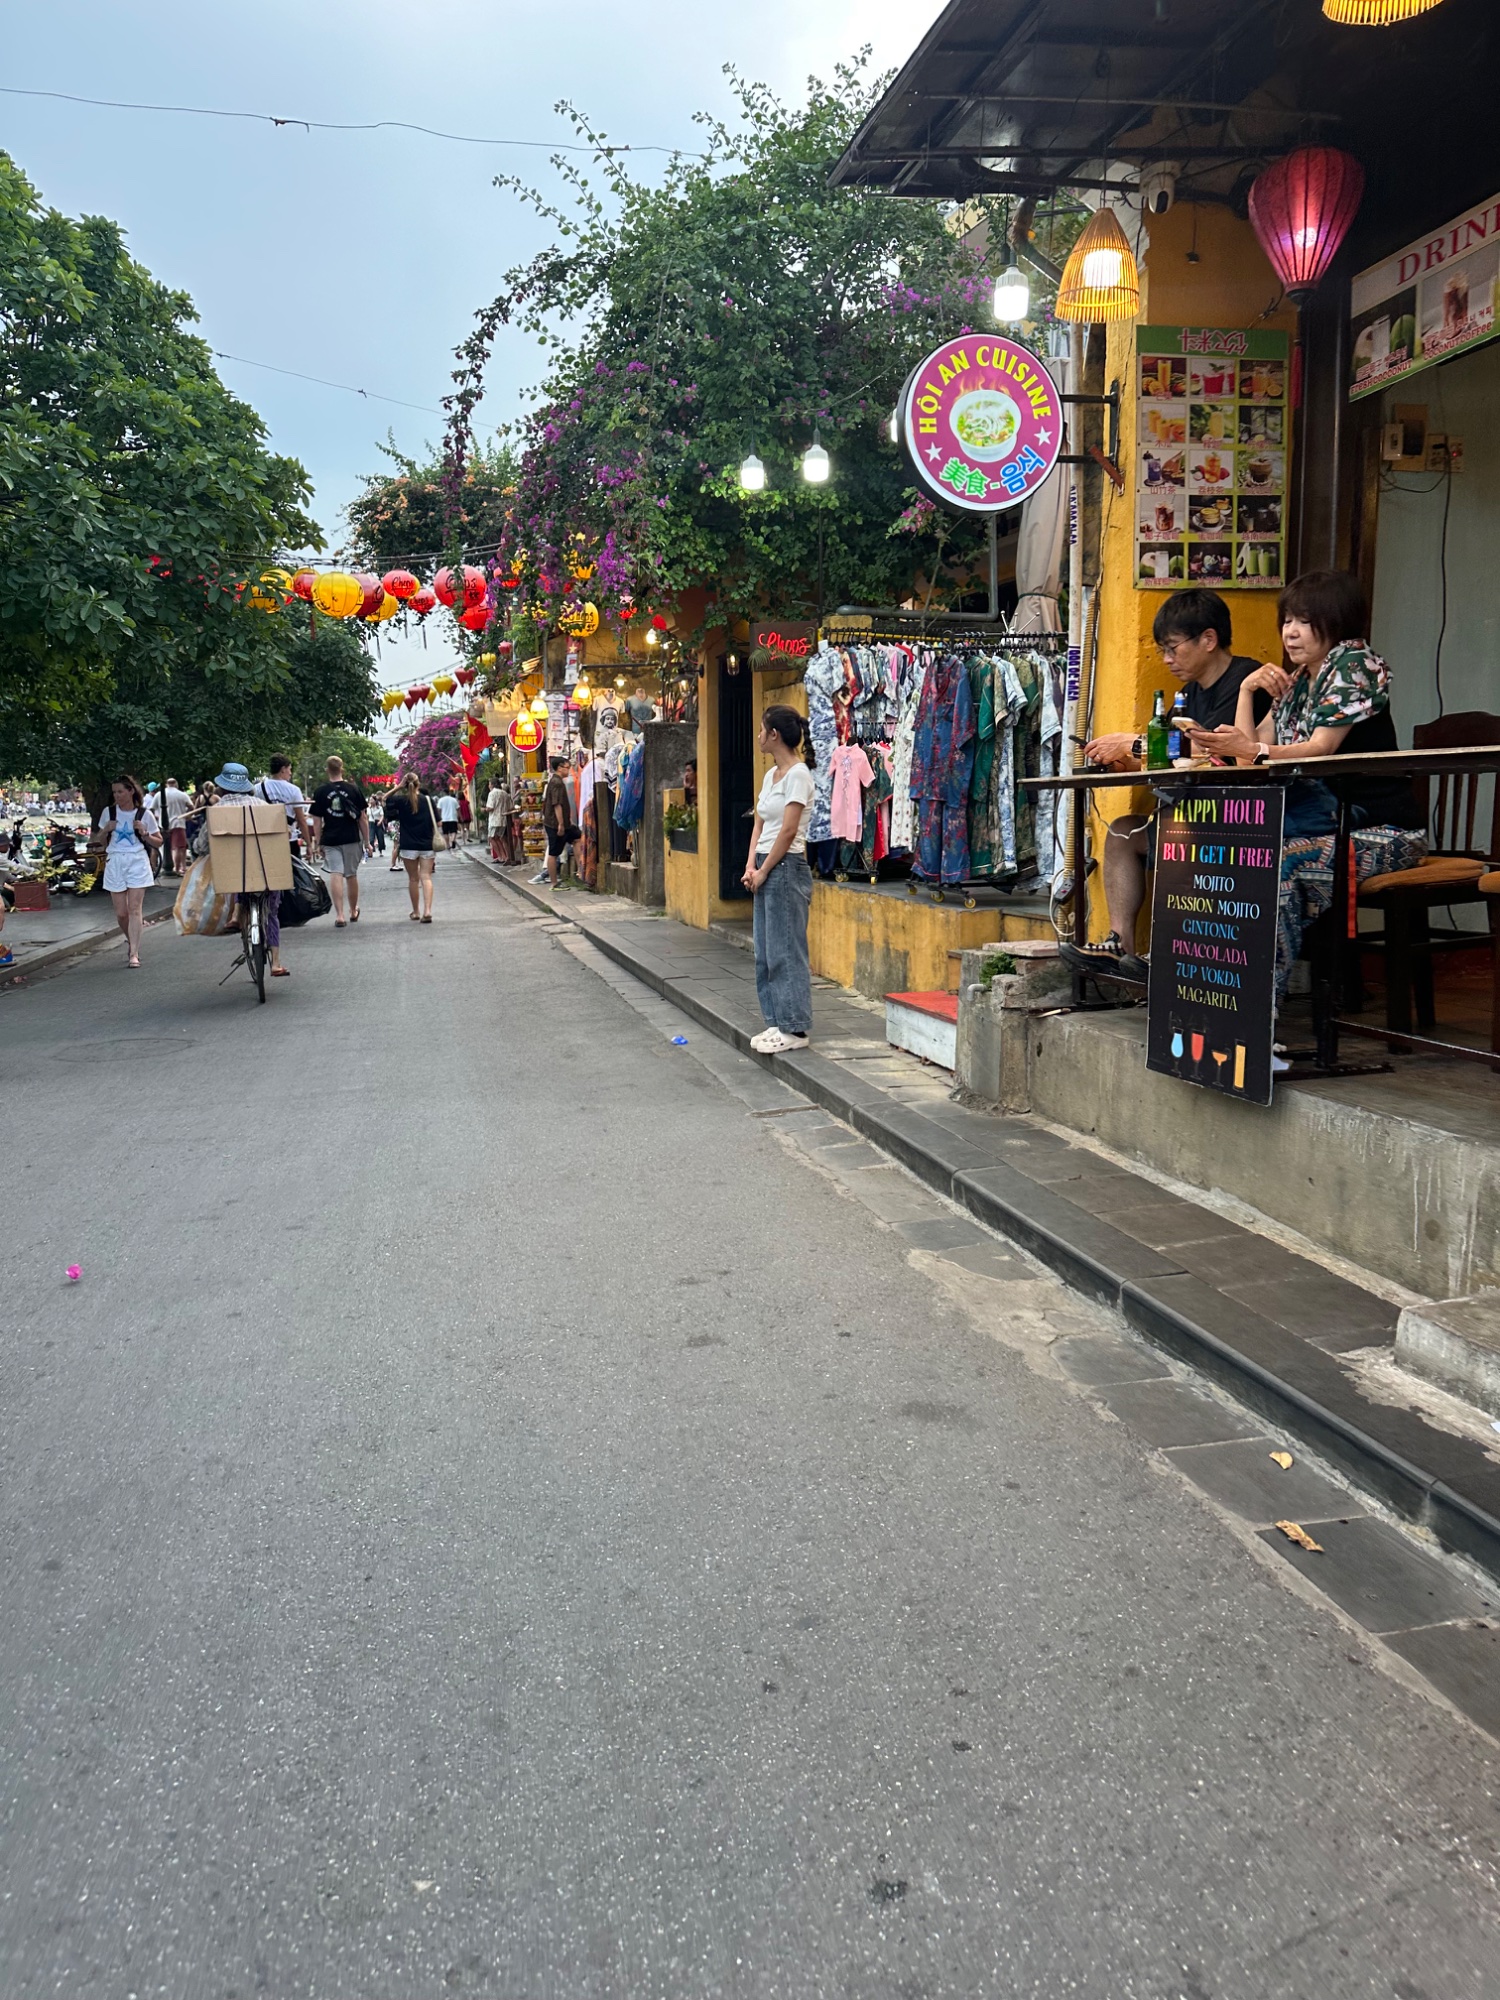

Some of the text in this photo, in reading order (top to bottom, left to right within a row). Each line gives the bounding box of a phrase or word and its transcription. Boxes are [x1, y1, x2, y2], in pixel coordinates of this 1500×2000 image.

[938, 349, 971, 386] AN
[975, 345, 1053, 420] CUISINE
[514, 735, 538, 746] MART
[1173, 798, 1266, 825] HAPPY HOUR
[1163, 842, 1188, 862] BUY
[1199, 845, 1226, 865] GET
[1238, 846, 1274, 868] FREE
[1193, 874, 1235, 893] MOJITO
[1167, 894, 1260, 920] PASSION MOJITO
[1172, 939, 1248, 966] PINACOLADA
[1175, 962, 1242, 989] 7UP VOKDA
[1176, 984, 1238, 1012] MAGARITA
